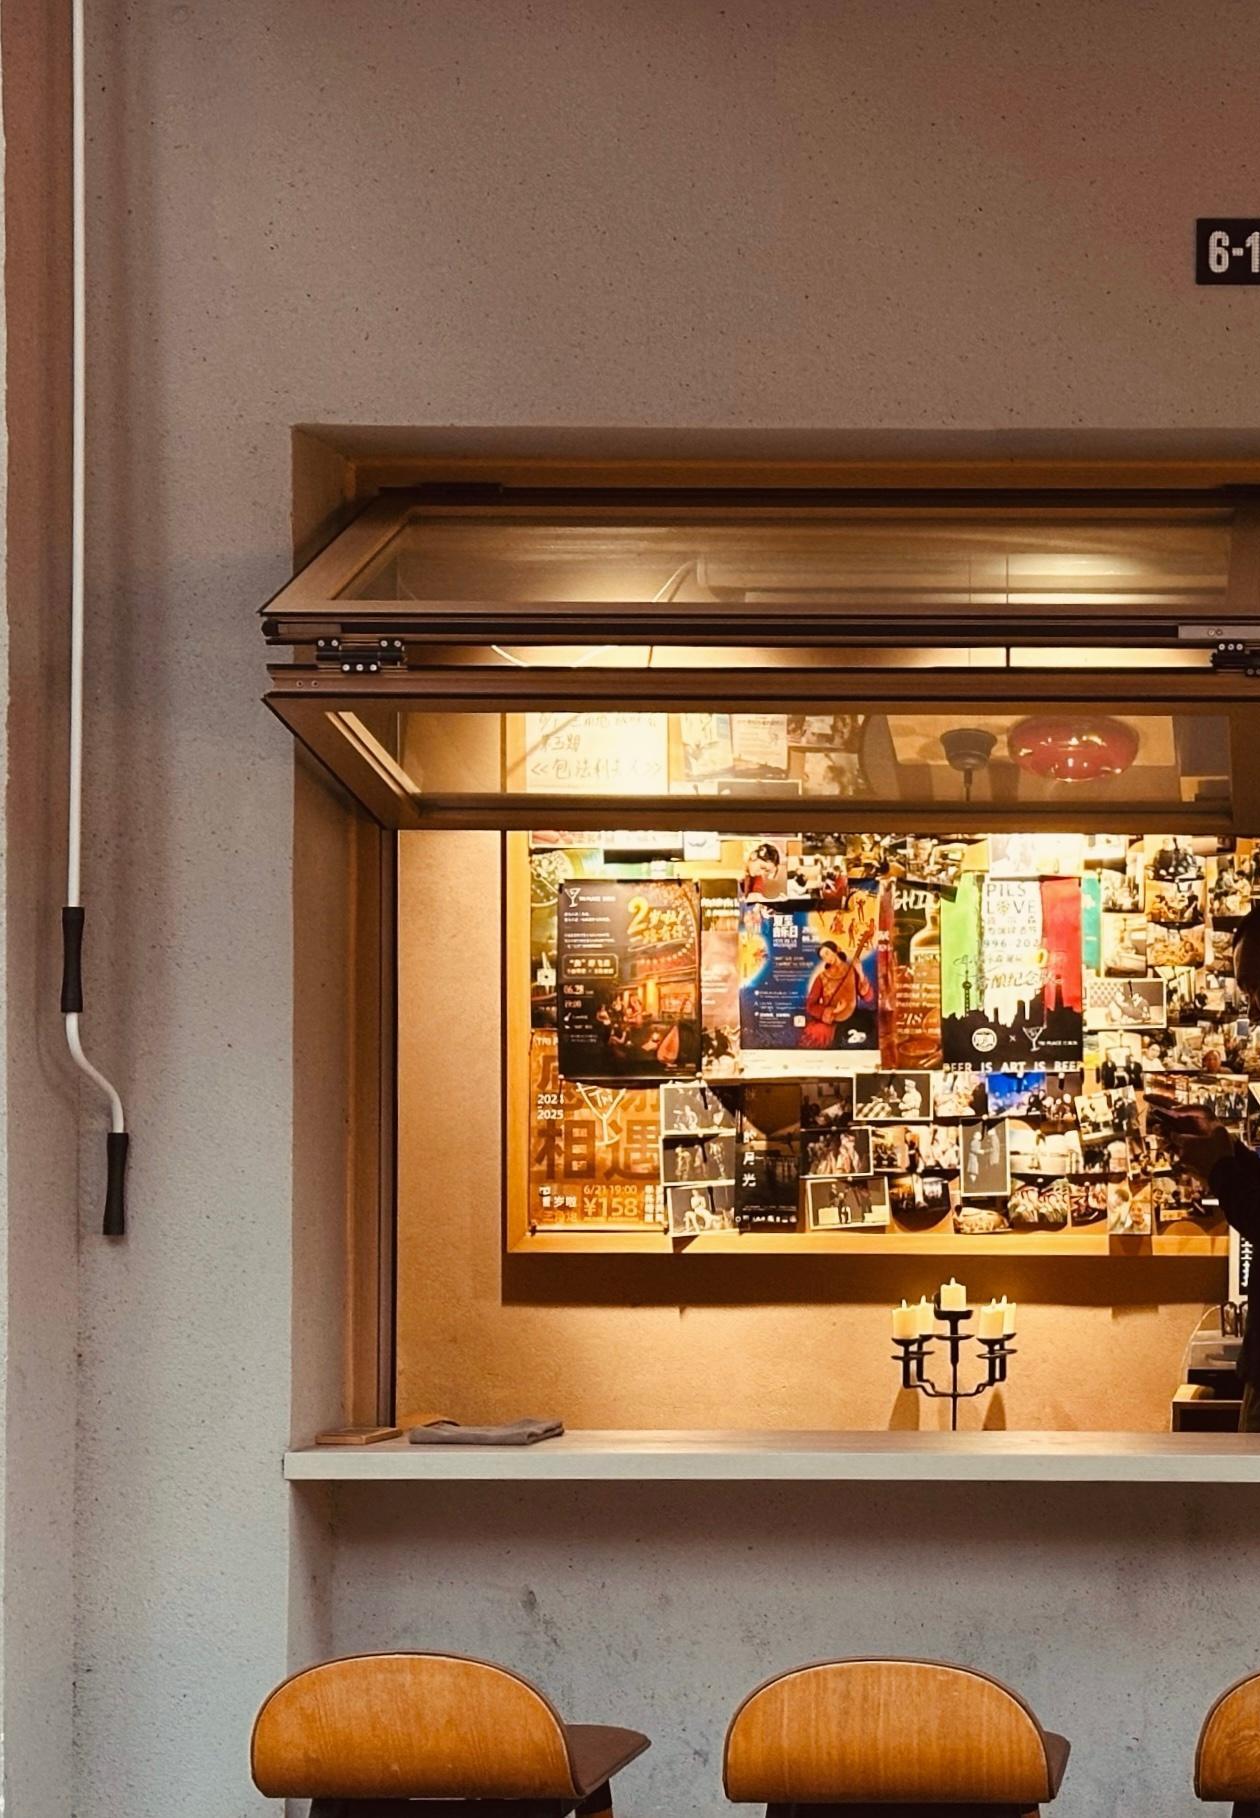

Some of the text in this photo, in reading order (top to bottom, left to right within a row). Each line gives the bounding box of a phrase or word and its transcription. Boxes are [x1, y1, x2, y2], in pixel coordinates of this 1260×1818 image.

[986, 883, 1026, 897] PILS
[980, 1062, 993, 1073] IS
[1000, 1061, 1026, 1073] ART
[1033, 1061, 1047, 1072] IS
[536, 1109, 564, 1120] 2025
[583, 1184, 638, 1195] 6/21 19:00
[583, 1197, 638, 1217] ¥158
